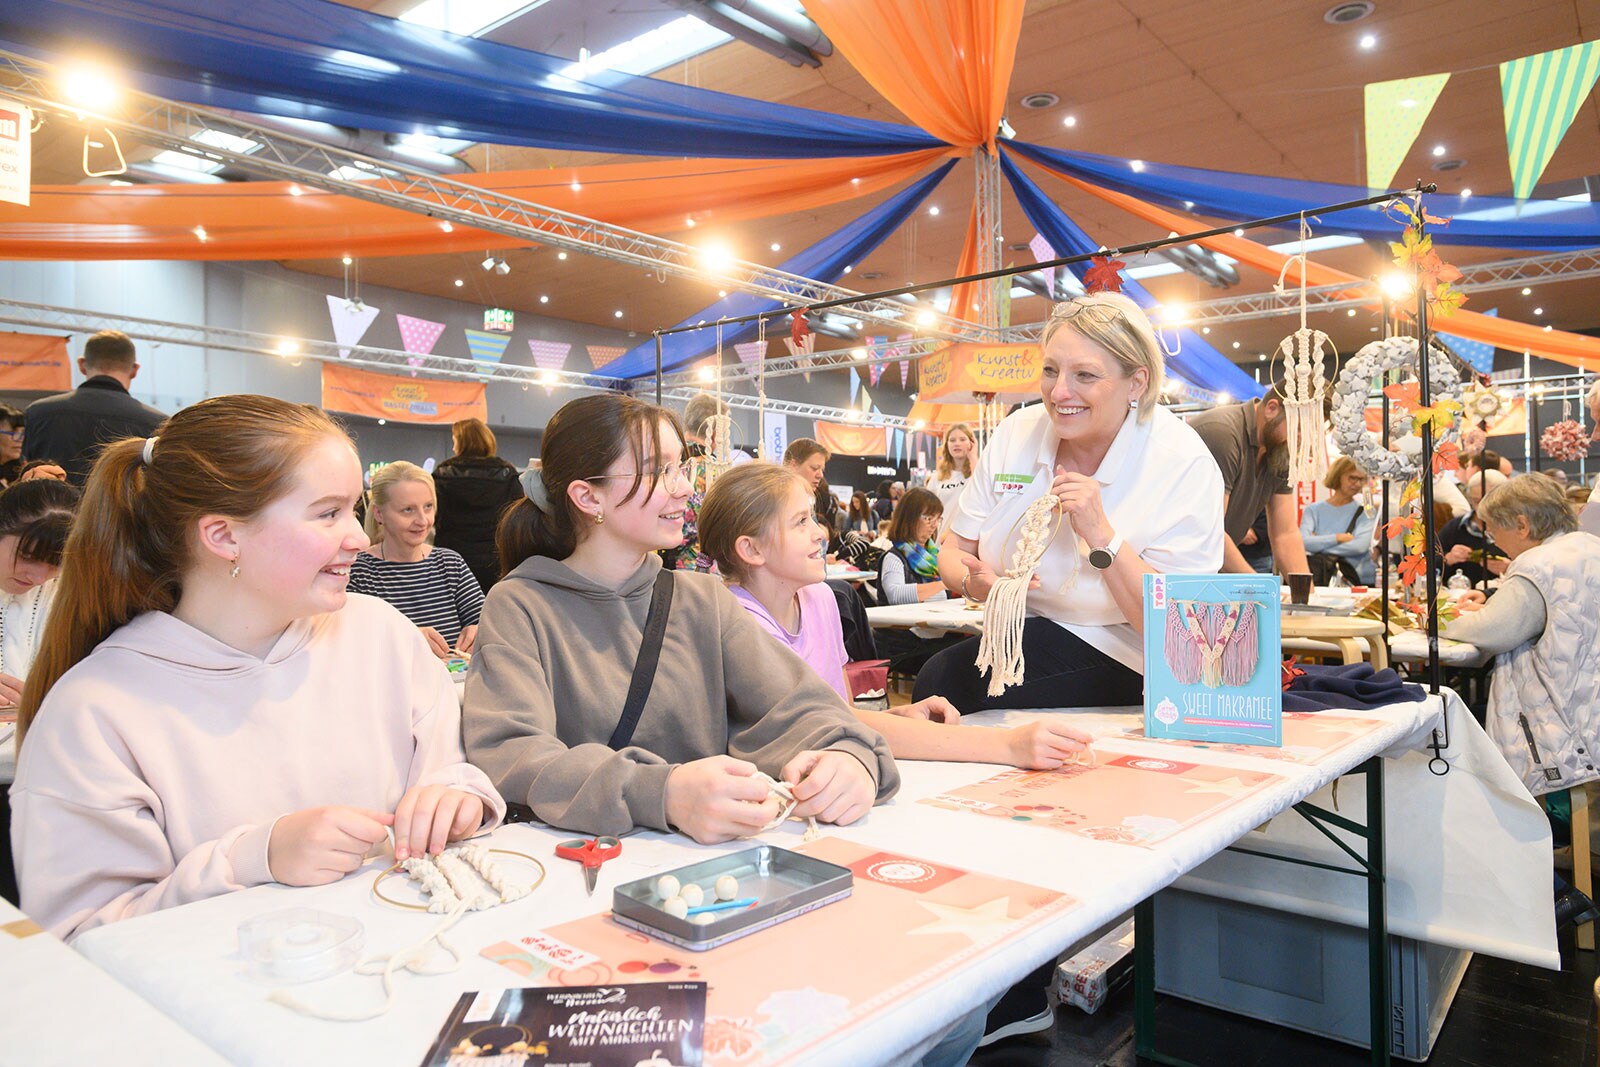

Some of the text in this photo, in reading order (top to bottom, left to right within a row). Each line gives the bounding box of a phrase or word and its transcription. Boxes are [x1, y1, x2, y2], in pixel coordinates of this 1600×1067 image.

[1001, 483, 1024, 491] TOPP
[1155, 578, 1164, 607] TOPP
[1182, 692, 1212, 716] SWEET
[1217, 694, 1273, 720] MAKRAMEE
[548, 1018, 694, 1039] WEIHNACHTEN
[569, 1031, 675, 1047] MIT MAKRAMEE
